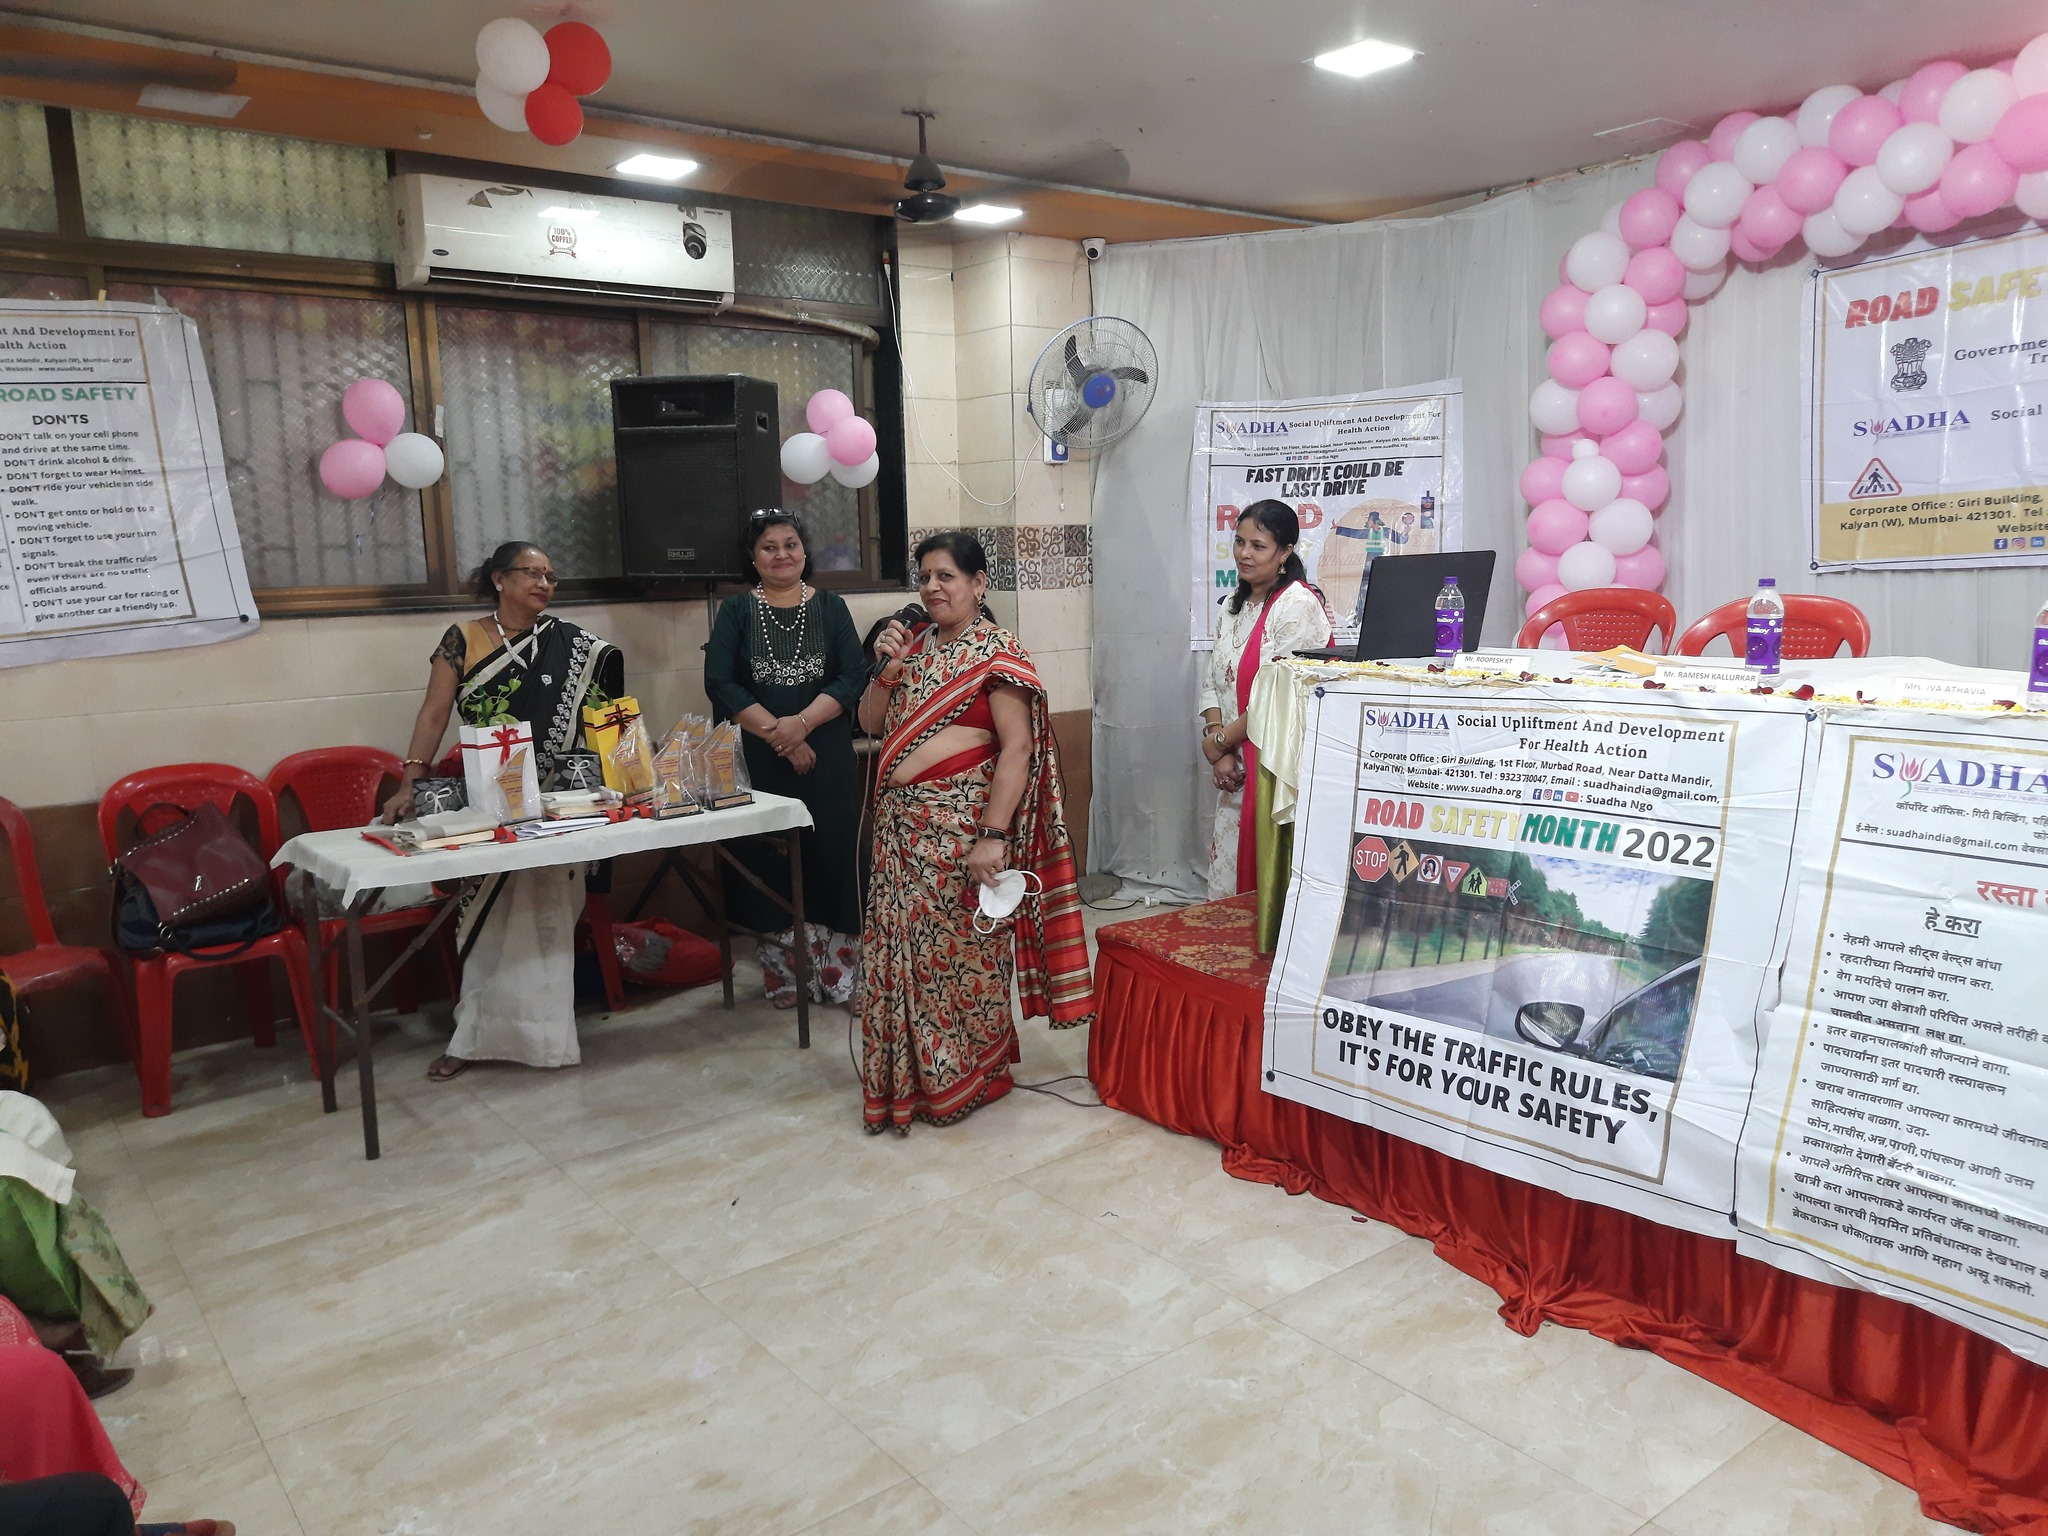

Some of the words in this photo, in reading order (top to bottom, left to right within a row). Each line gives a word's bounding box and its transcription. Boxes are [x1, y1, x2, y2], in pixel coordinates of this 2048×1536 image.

[552, 235, 573, 244] COPPER
[553, 228, 571, 236] 100%
[1845, 286, 1939, 329] ROAD
[12, 326, 35, 336] And
[40, 327, 115, 338] Development
[119, 328, 136, 337] For
[28, 341, 66, 350] Action
[61, 387, 137, 401] SAFETY
[32, 414, 89, 425] DON'TS
[1991, 404, 2043, 421] Social
[1289, 420, 1311, 428] Social
[1314, 418, 1355, 427] Upliftment
[1337, 427, 1363, 435] Health
[33, 430, 52, 440] talk
[69, 432, 91, 442] your
[94, 430, 109, 438] cell
[112, 430, 139, 439] phone
[23, 445, 48, 454] drive
[4, 458, 35, 467] DON'T
[38, 457, 64, 466] drink
[66, 456, 100, 465] alcohol
[40, 470, 70, 481] forget
[84, 470, 108, 478] wear
[1246, 468, 1284, 483] FAST
[1287, 465, 1330, 481] DRIVE
[1333, 462, 1382, 479] COULD
[1384, 461, 1405, 476] BE
[1281, 482, 1321, 498] LAST
[1323, 479, 1367, 496] DRIVE
[1849, 504, 1907, 516] Corporate
[1911, 501, 1947, 511] Office
[1957, 498, 1980, 508] Giri
[1985, 494, 2043, 506] Building,
[1216, 503, 1323, 532] RD
[1840, 519, 1878, 531] Kalyan
[1881, 517, 1905, 528] (W),
[1908, 513, 1963, 525] Mumbai-
[1966, 510, 2016, 521] 421301.
[2024, 508, 2043, 517] Tel
[17, 523, 53, 533] moving
[55, 521, 92, 530] vehicle.
[22, 549, 58, 560] signals.
[58, 559, 85, 568] break
[105, 556, 134, 565] traffic
[29, 586, 68, 595] officials
[70, 582, 107, 592] around.
[57, 609, 95, 618] another
[122, 601, 158, 612] friendly
[1678, 672, 1709, 680] RAMESH
[1711, 673, 1756, 682] KALLURKAR
[1457, 715, 1496, 728] Social
[1502, 716, 1577, 732] Upliftment
[1582, 719, 1613, 734] And
[1618, 722, 1725, 743] Development
[1519, 738, 1540, 750] For
[1544, 739, 1589, 753] Health
[1594, 742, 1648, 759] Action
[1369, 750, 1407, 763] Corporate
[1410, 753, 1434, 763] Office
[1441, 755, 1457, 764] Giri
[1458, 756, 1496, 769] Building,
[1499, 759, 1513, 767] 1st
[1540, 761, 1573, 771] Murbad
[1576, 763, 1605, 776] Road,
[1608, 767, 1635, 778] Near
[1638, 770, 1669, 782] Datta
[1671, 774, 1713, 788] Mandir,
[1363, 762, 1389, 773] Kalyan
[1445, 769, 1477, 779] 421301.
[1480, 771, 1493, 780] Tel
[1551, 775, 1575, 786] Email
[1583, 779, 1720, 805] suadhaindia@gmail.com,
[1407, 780, 1439, 790] Website
[1446, 784, 1522, 799] www.suadha.org
[1586, 795, 1627, 808] Suadha
[1630, 800, 1653, 813] Ngo
[1364, 798, 1425, 830] ROAD
[1430, 804, 1522, 841] SAFETY
[1520, 813, 1621, 854] MONTH
[1622, 828, 1715, 868] 2022
[1886, 828, 2018, 851] suadhaindia@gmail.com
[1356, 850, 1388, 869] STOP
[1977, 880, 2038, 908] रस्ता
[1924, 906, 1940, 930] हे
[1945, 914, 1982, 936] करा
[1843, 932, 1870, 947] नेहमी
[1874, 939, 1905, 954] आपले
[1976, 956, 2003, 972] बांधा
[1893, 960, 1935, 979] नियमांचे
[1937, 970, 1967, 985] पालन
[1970, 978, 1994, 991] करा.
[1833, 989, 1866, 1004] आपण
[1929, 1009, 1968, 1026] परिचित
[1971, 1019, 2003, 1033] असले
[1875, 1018, 1920, 1035] असताना
[1826, 1025, 1848, 1037] इतर
[1982, 1060, 2010, 1076] वागा.
[1323, 1008, 1383, 1041] OBEY
[1389, 1023, 1436, 1057] THE
[1444, 1037, 1543, 1087] TRAFFIC
[1550, 1066, 1658, 1123] RULES,
[1904, 1062, 1945, 1080] पादचारी
[1339, 1040, 1381, 1071] IT'S
[1385, 1053, 1433, 1090] FOR
[1441, 1069, 1510, 1113] YOUR
[1518, 1092, 1627, 1144] SAFETY
[1815, 1080, 1844, 1095] खराब
[1906, 1104, 1950, 1123] आपल्या
[1794, 1172, 1821, 1188] खात्री
[1876, 1176, 1901, 1190] टायर
[2005, 1172, 2035, 1190] उत्तम
[1932, 1253, 1963, 1272] महाग
